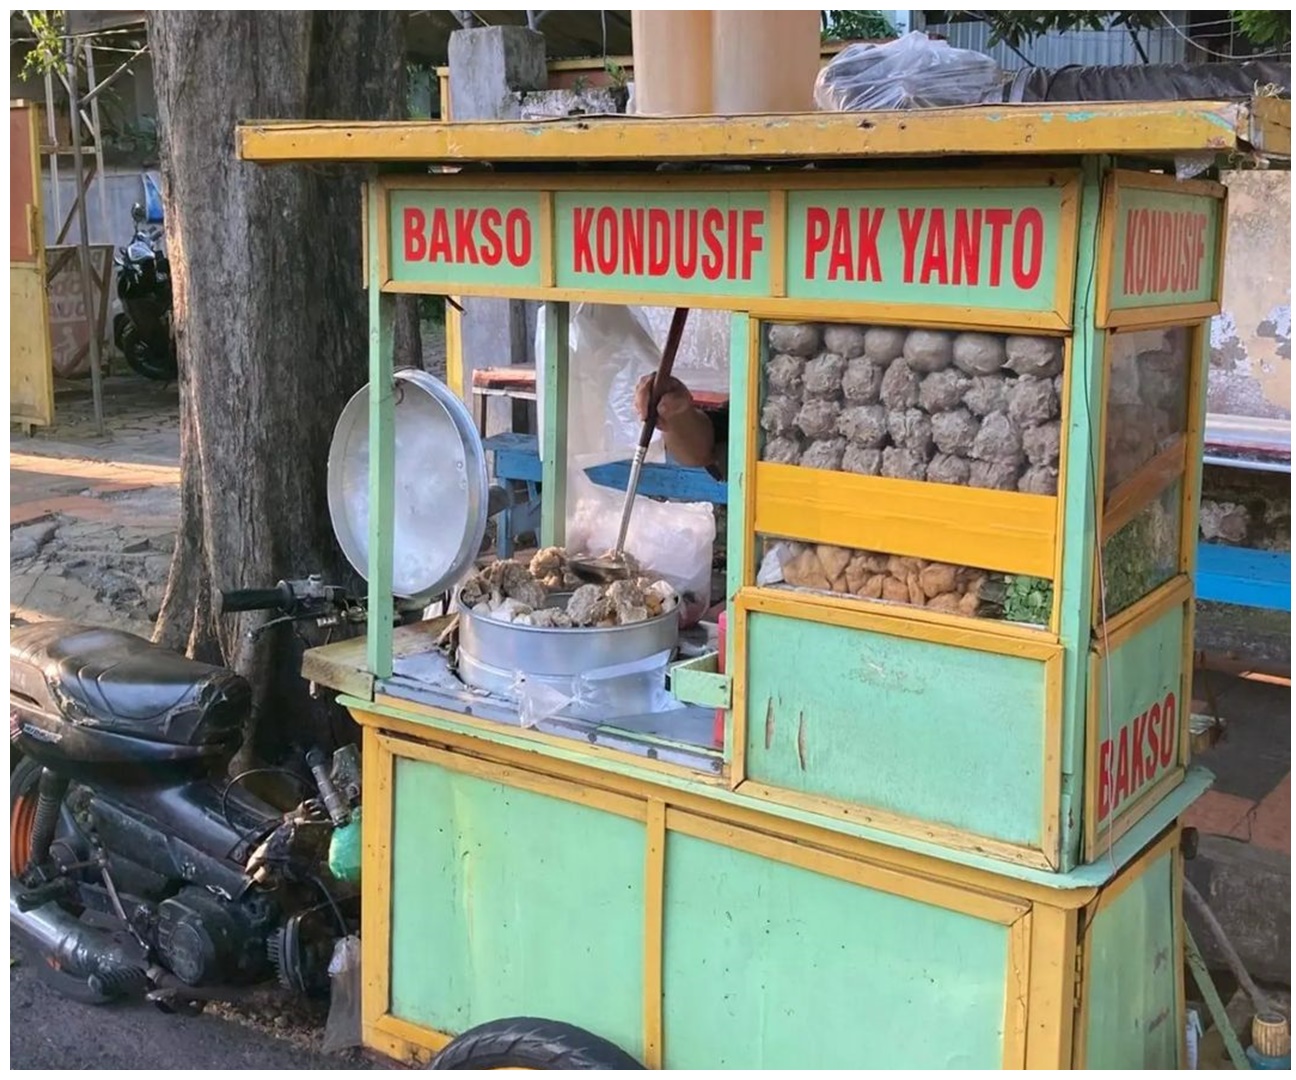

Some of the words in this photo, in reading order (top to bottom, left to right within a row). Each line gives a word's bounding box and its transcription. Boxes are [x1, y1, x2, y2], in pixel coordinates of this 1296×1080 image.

[402, 207, 532, 267] BAKSO
[572, 206, 765, 280] KONDUSIF
[804, 206, 885, 282] PAK
[897, 206, 1043, 289] YANTO
[1123, 208, 1207, 295] KONDUSIF
[1098, 691, 1175, 822] BAKSO
